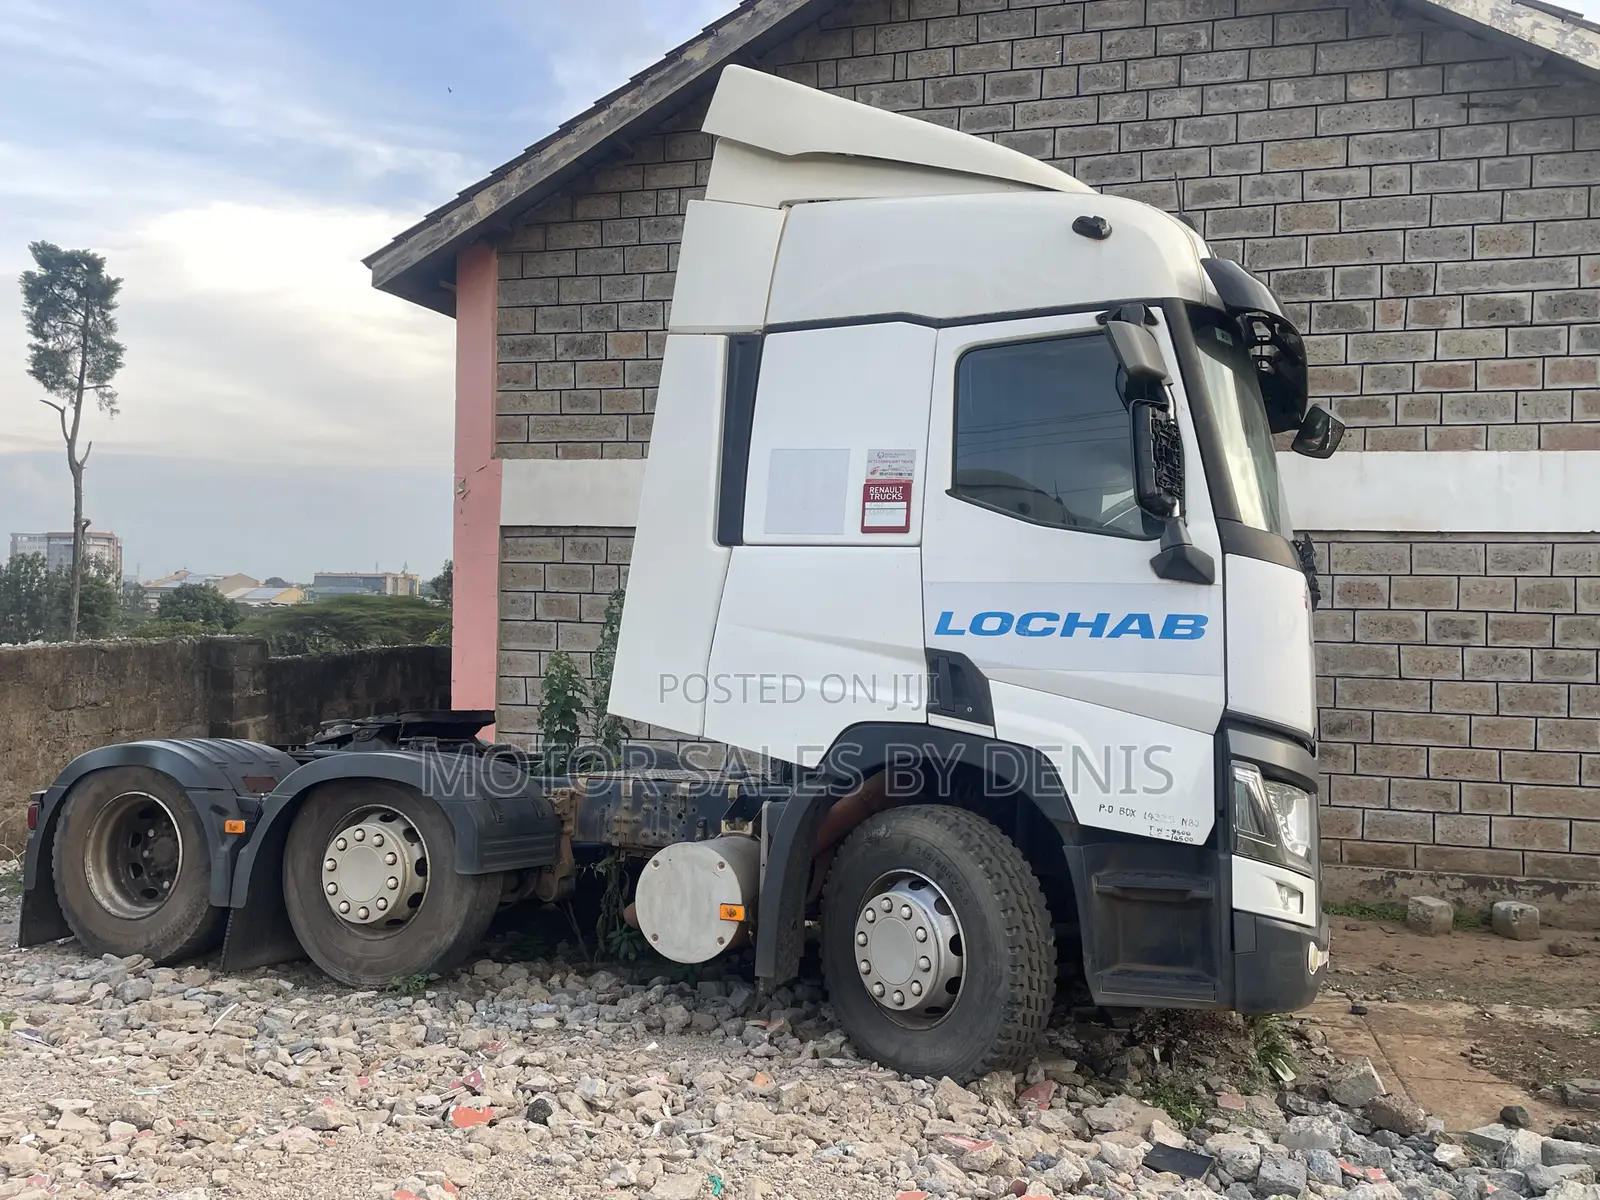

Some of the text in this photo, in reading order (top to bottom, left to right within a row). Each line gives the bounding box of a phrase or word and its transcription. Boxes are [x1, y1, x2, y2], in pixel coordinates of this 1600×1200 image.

[869, 486, 904, 494] RENAULT
[869, 492, 904, 500] TRUCKS
[934, 611, 1209, 640] LOCHAB
[1119, 806, 1137, 818] BOX
